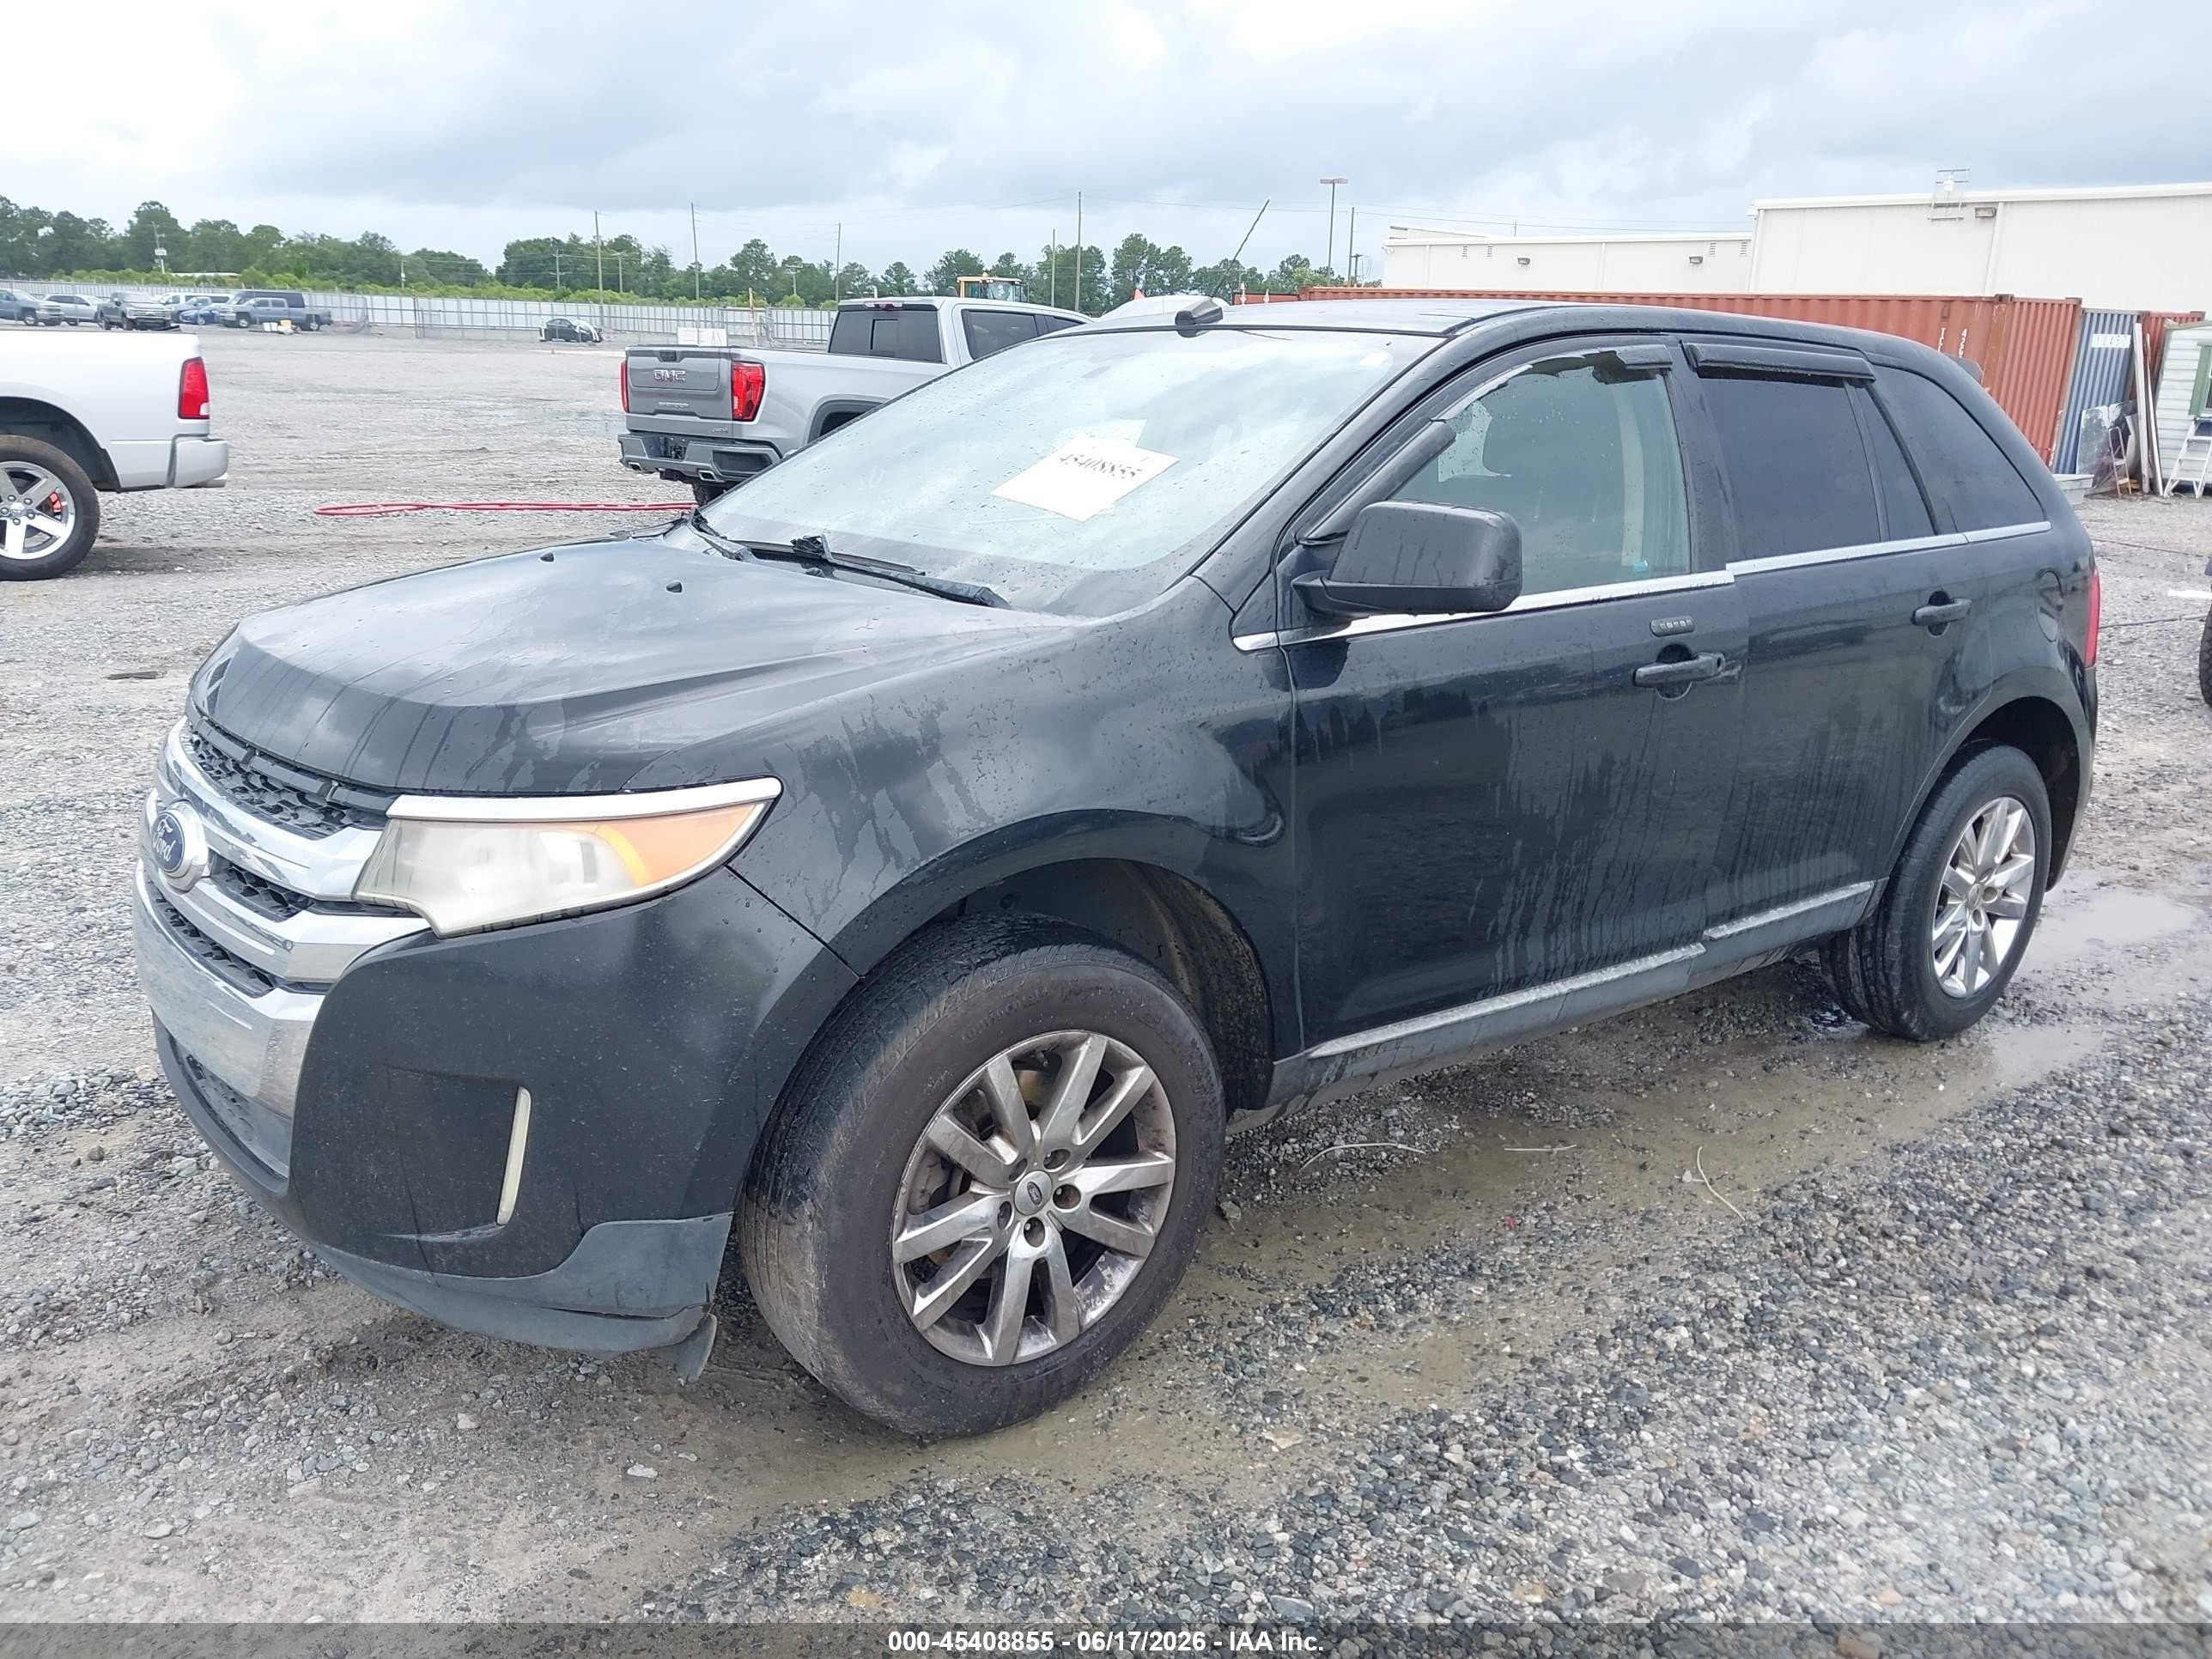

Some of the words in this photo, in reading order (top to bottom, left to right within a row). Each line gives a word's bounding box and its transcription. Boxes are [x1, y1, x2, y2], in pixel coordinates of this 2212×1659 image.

[1959, 328, 1967, 358] 42G
[653, 368, 687, 382] GMC
[153, 815, 177, 862] Ford
